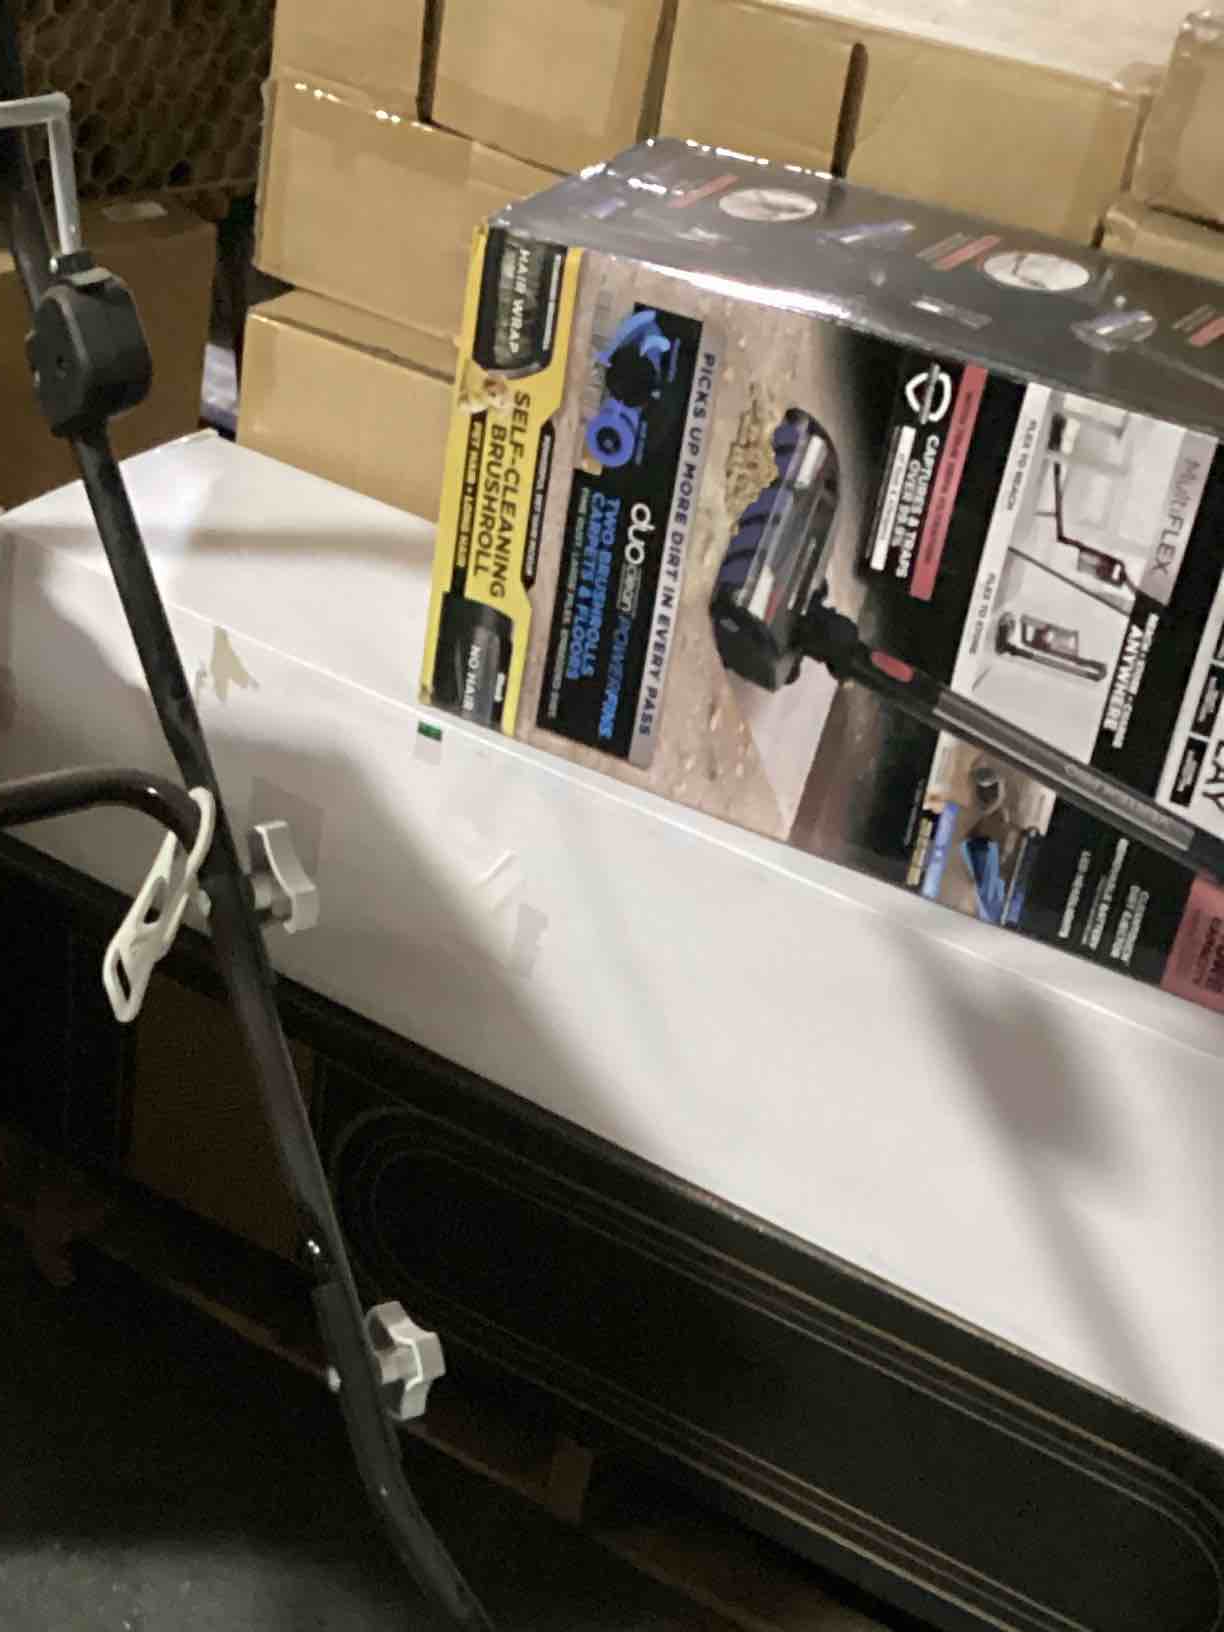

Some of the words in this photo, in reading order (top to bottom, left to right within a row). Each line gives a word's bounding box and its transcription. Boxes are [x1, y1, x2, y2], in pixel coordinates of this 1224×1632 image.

[512, 249, 531, 298] HAIR
[508, 299, 526, 353] WRAP
[693, 353, 716, 420] PICKS
[687, 425, 703, 450] UP
[473, 424, 507, 576] BRUSHROLL
[489, 391, 531, 598] SELF-CLEANING
[673, 463, 698, 525] MORE
[666, 533, 684, 580] DIRT
[660, 588, 676, 608] IN
[466, 645, 481, 670] NO
[643, 615, 671, 685] EVERY
[639, 687, 659, 735] PASS
